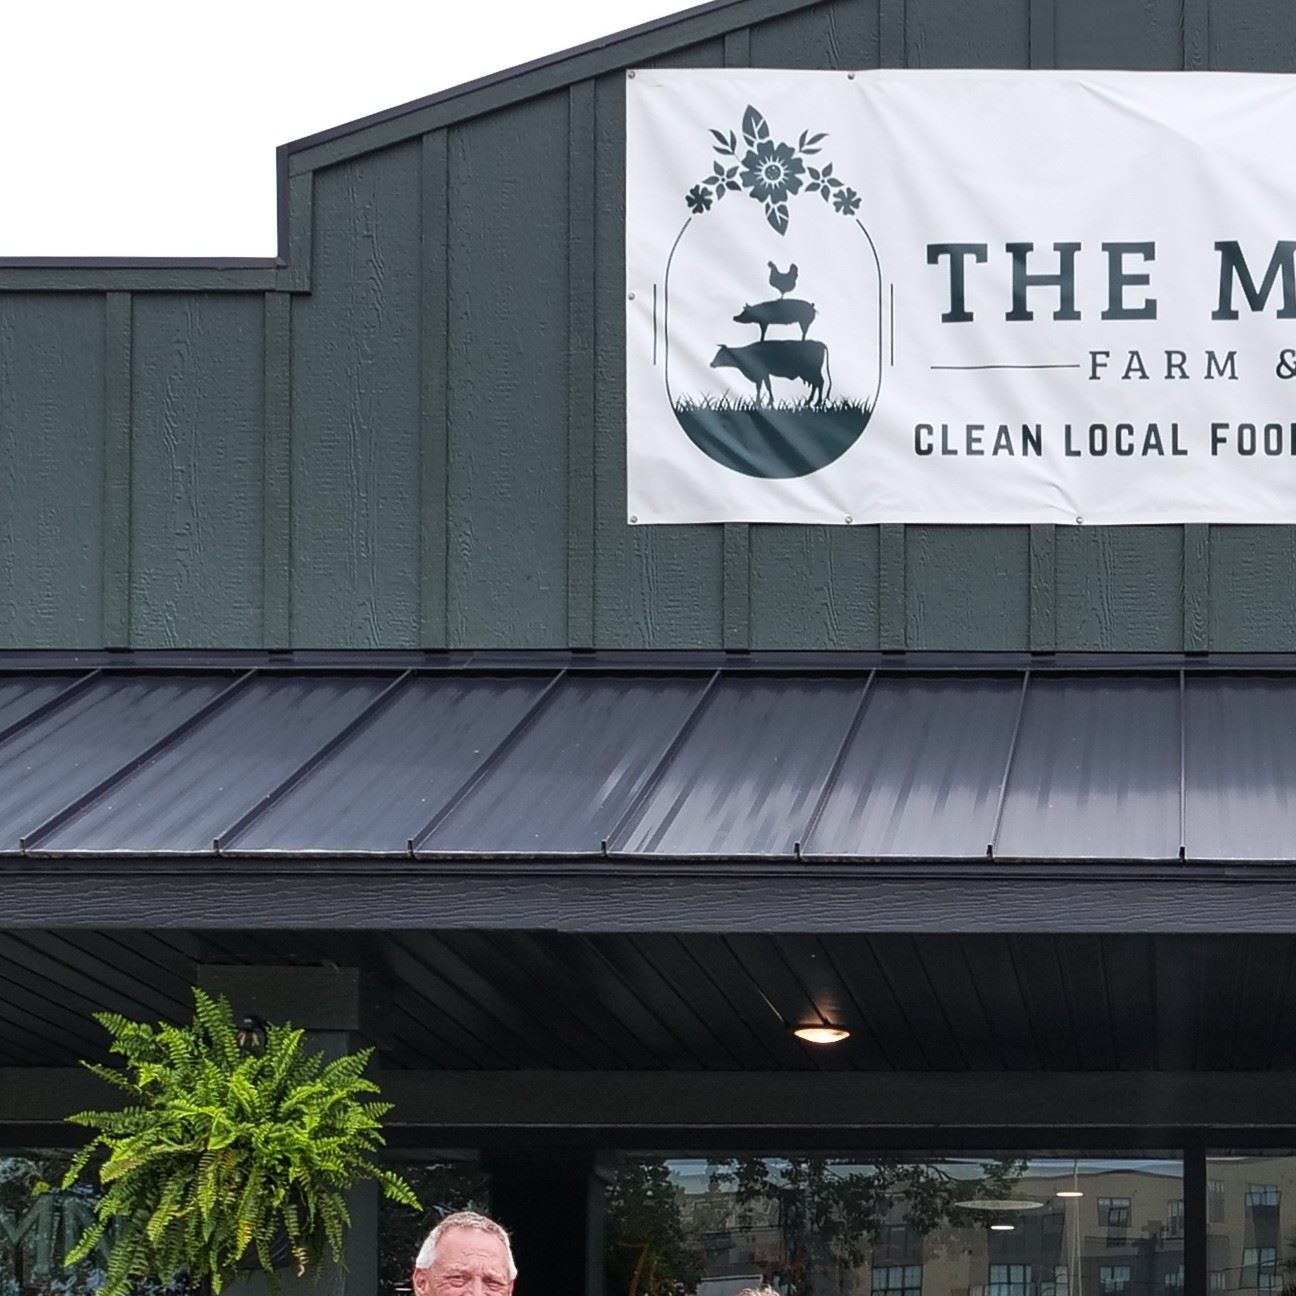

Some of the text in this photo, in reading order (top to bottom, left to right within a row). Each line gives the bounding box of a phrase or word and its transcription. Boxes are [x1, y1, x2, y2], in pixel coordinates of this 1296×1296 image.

[925, 240, 1158, 324] THE
[1087, 349, 1240, 382] FARM
[913, 422, 1043, 458] CLEAN
[1063, 421, 1189, 458] LOCAL
